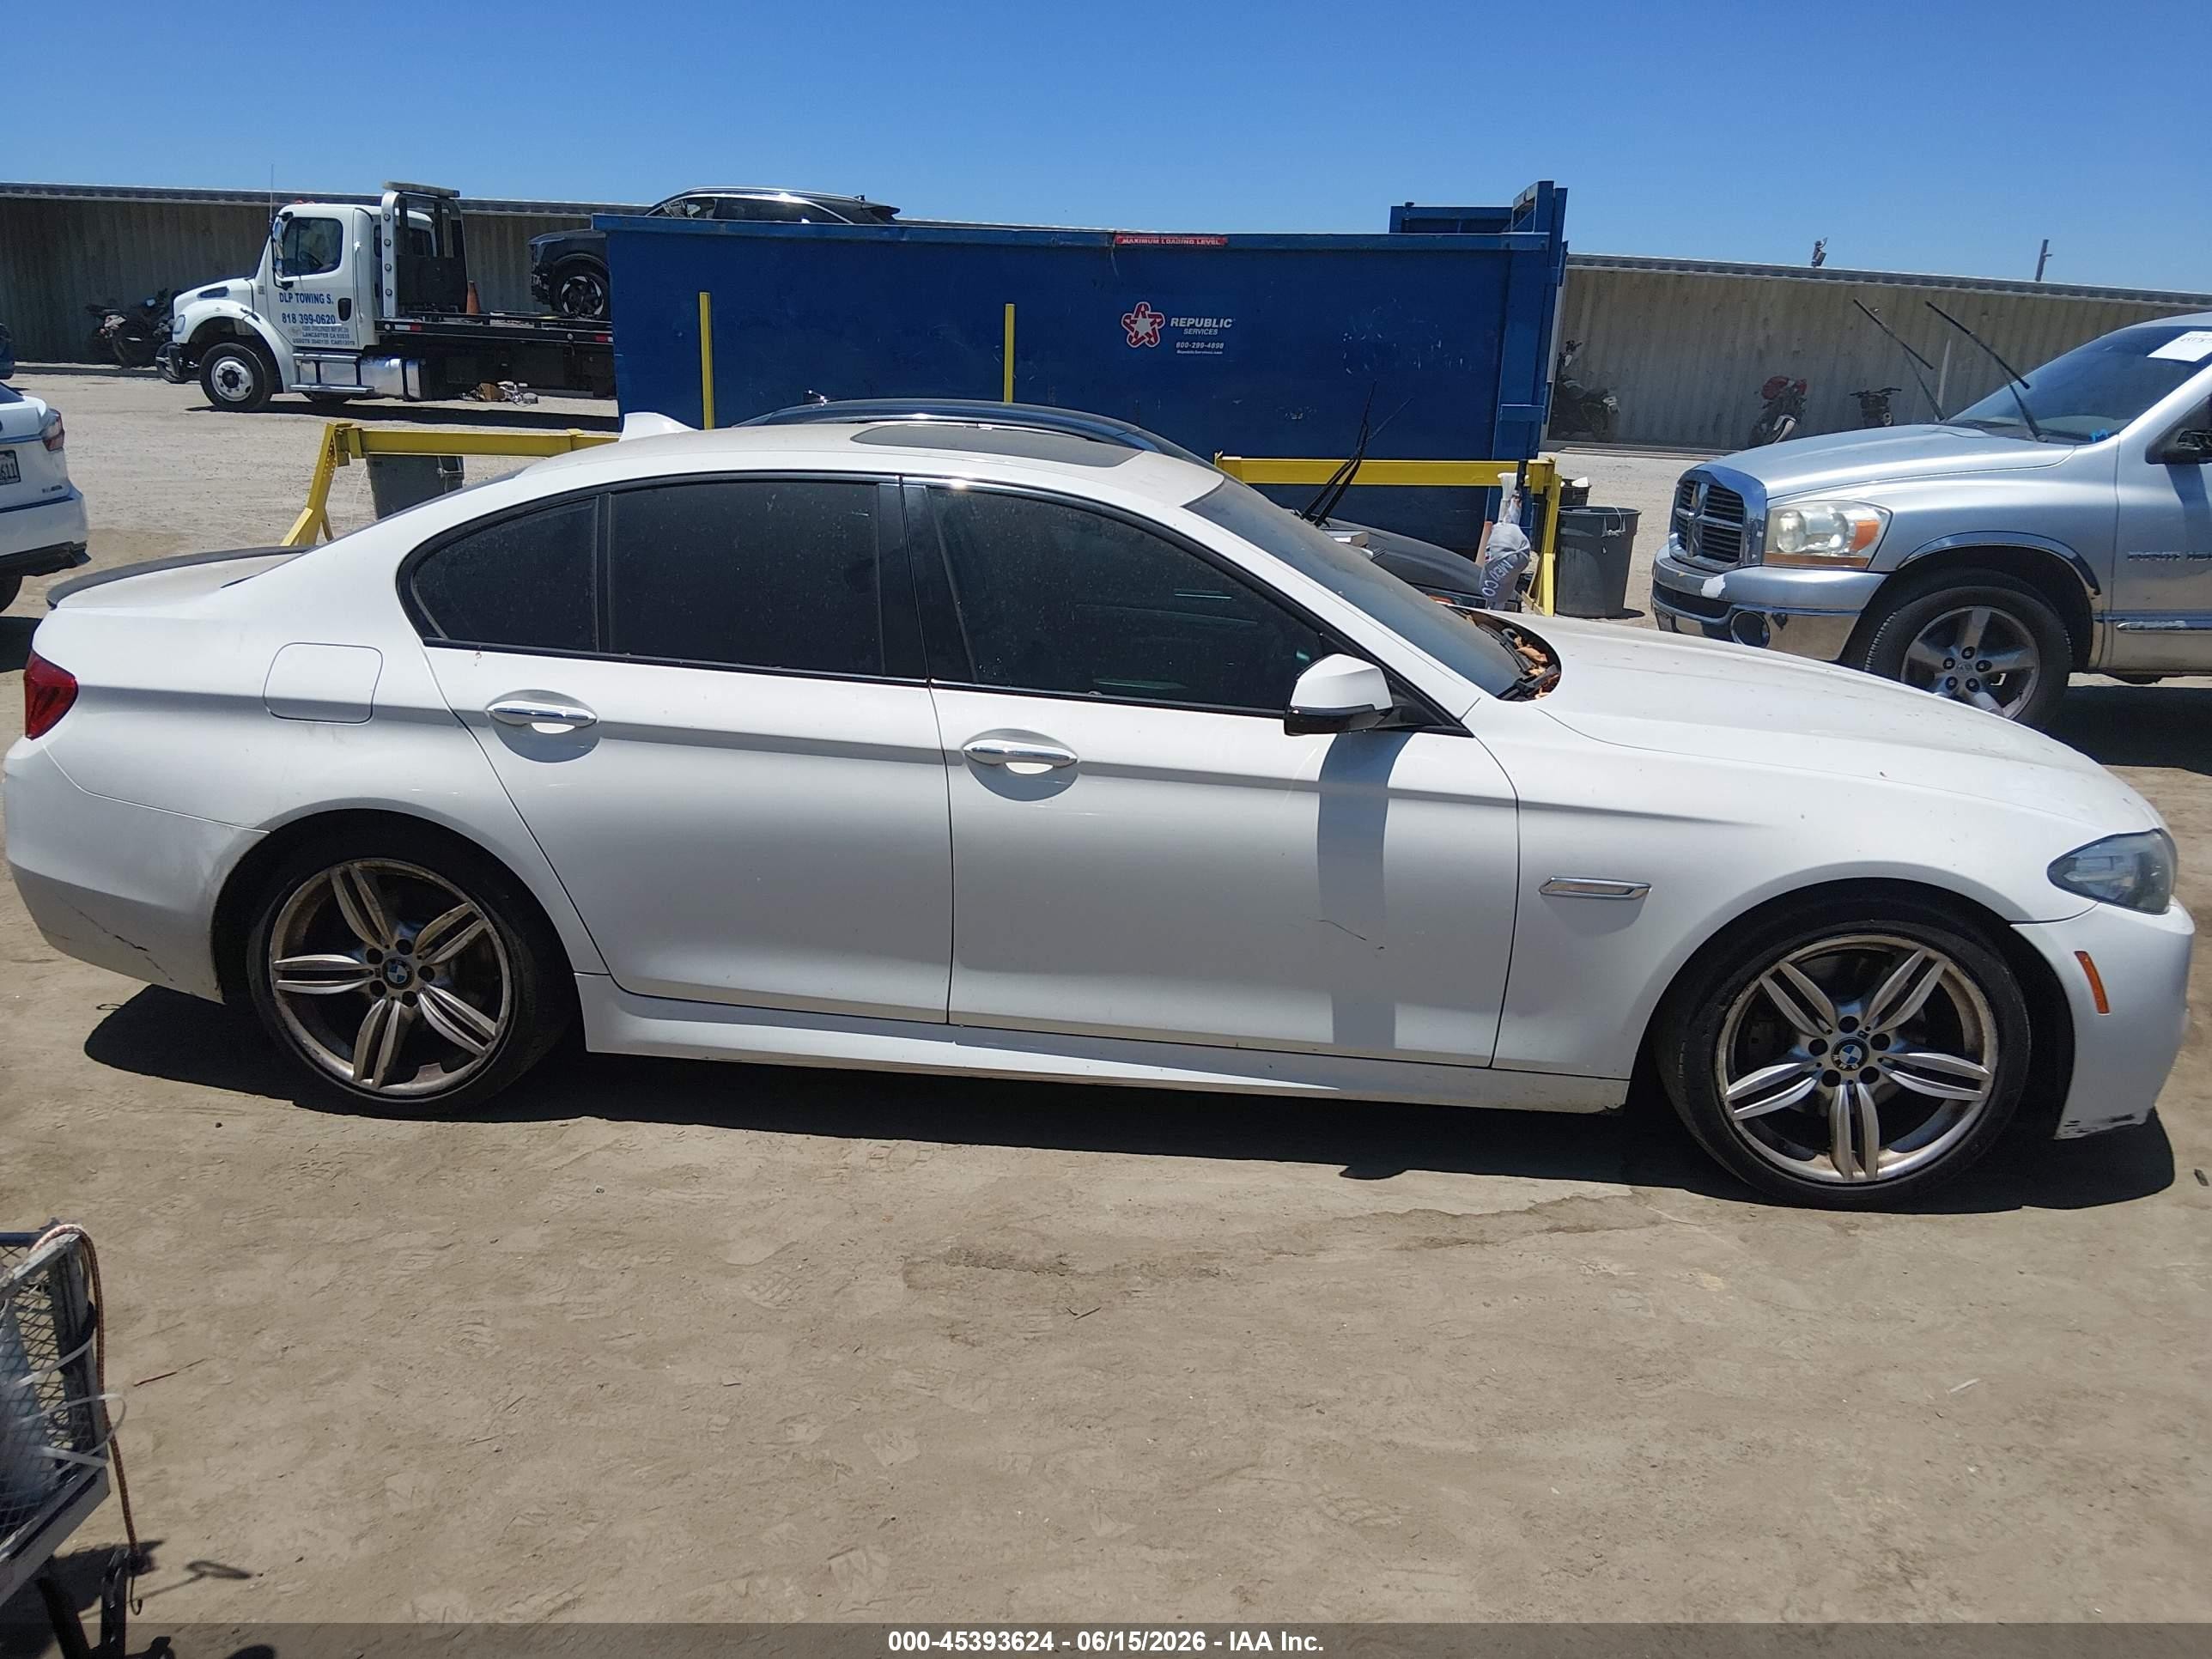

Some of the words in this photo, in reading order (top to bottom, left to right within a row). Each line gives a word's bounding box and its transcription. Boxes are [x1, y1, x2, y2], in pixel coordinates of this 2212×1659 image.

[279, 293, 293, 303] DLP
[295, 293, 325, 304] TOWING
[282, 313, 296, 324] 818
[299, 313, 336, 325] 399-0620
[1170, 318, 1233, 328] REPUBLIC
